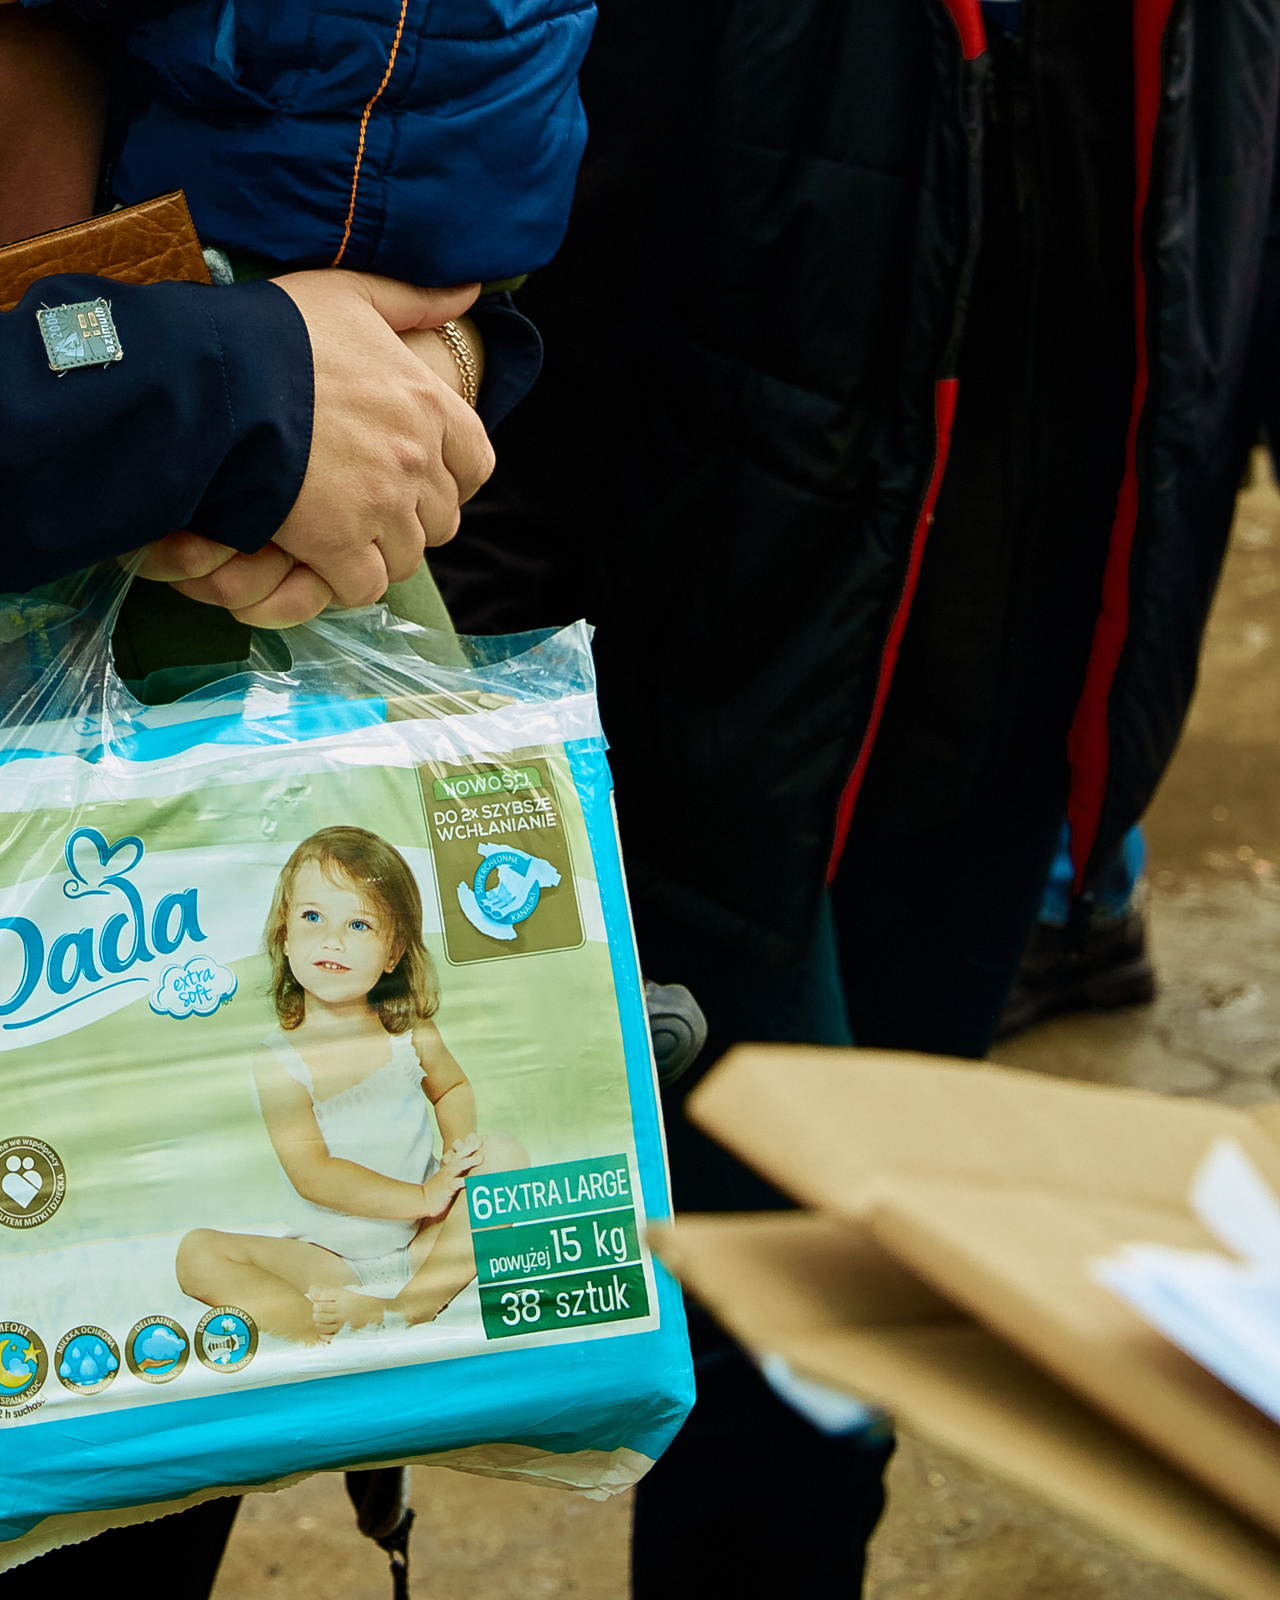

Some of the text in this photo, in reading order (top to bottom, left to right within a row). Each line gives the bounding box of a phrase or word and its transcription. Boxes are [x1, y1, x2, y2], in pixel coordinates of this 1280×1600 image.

[94, 306, 116, 353] azimuth
[433, 797, 553, 826] DO 2x SZYBSZE
[436, 813, 557, 842] WCHŁANIANIE
[510, 892, 537, 921] KANALIKI
[173, 966, 215, 993] extra
[178, 986, 213, 1012] soft
[22, 1138, 59, 1167] współpracy
[24, 1211, 49, 1227] MATKI
[52, 1173, 65, 1211] DZIECKA
[472, 1168, 629, 1220] 6 EXTRA LARGE
[489, 1221, 627, 1278] powyżej 15 kg
[500, 1274, 630, 1326] 38 sztuk
[134, 1316, 175, 1333] DELIKATNE
[197, 1306, 225, 1333] BARDZIEJ
[81, 1326, 116, 1349] OCHRONA
[27, 1380, 42, 1398] NOC
[5, 1409, 11, 1419] h
